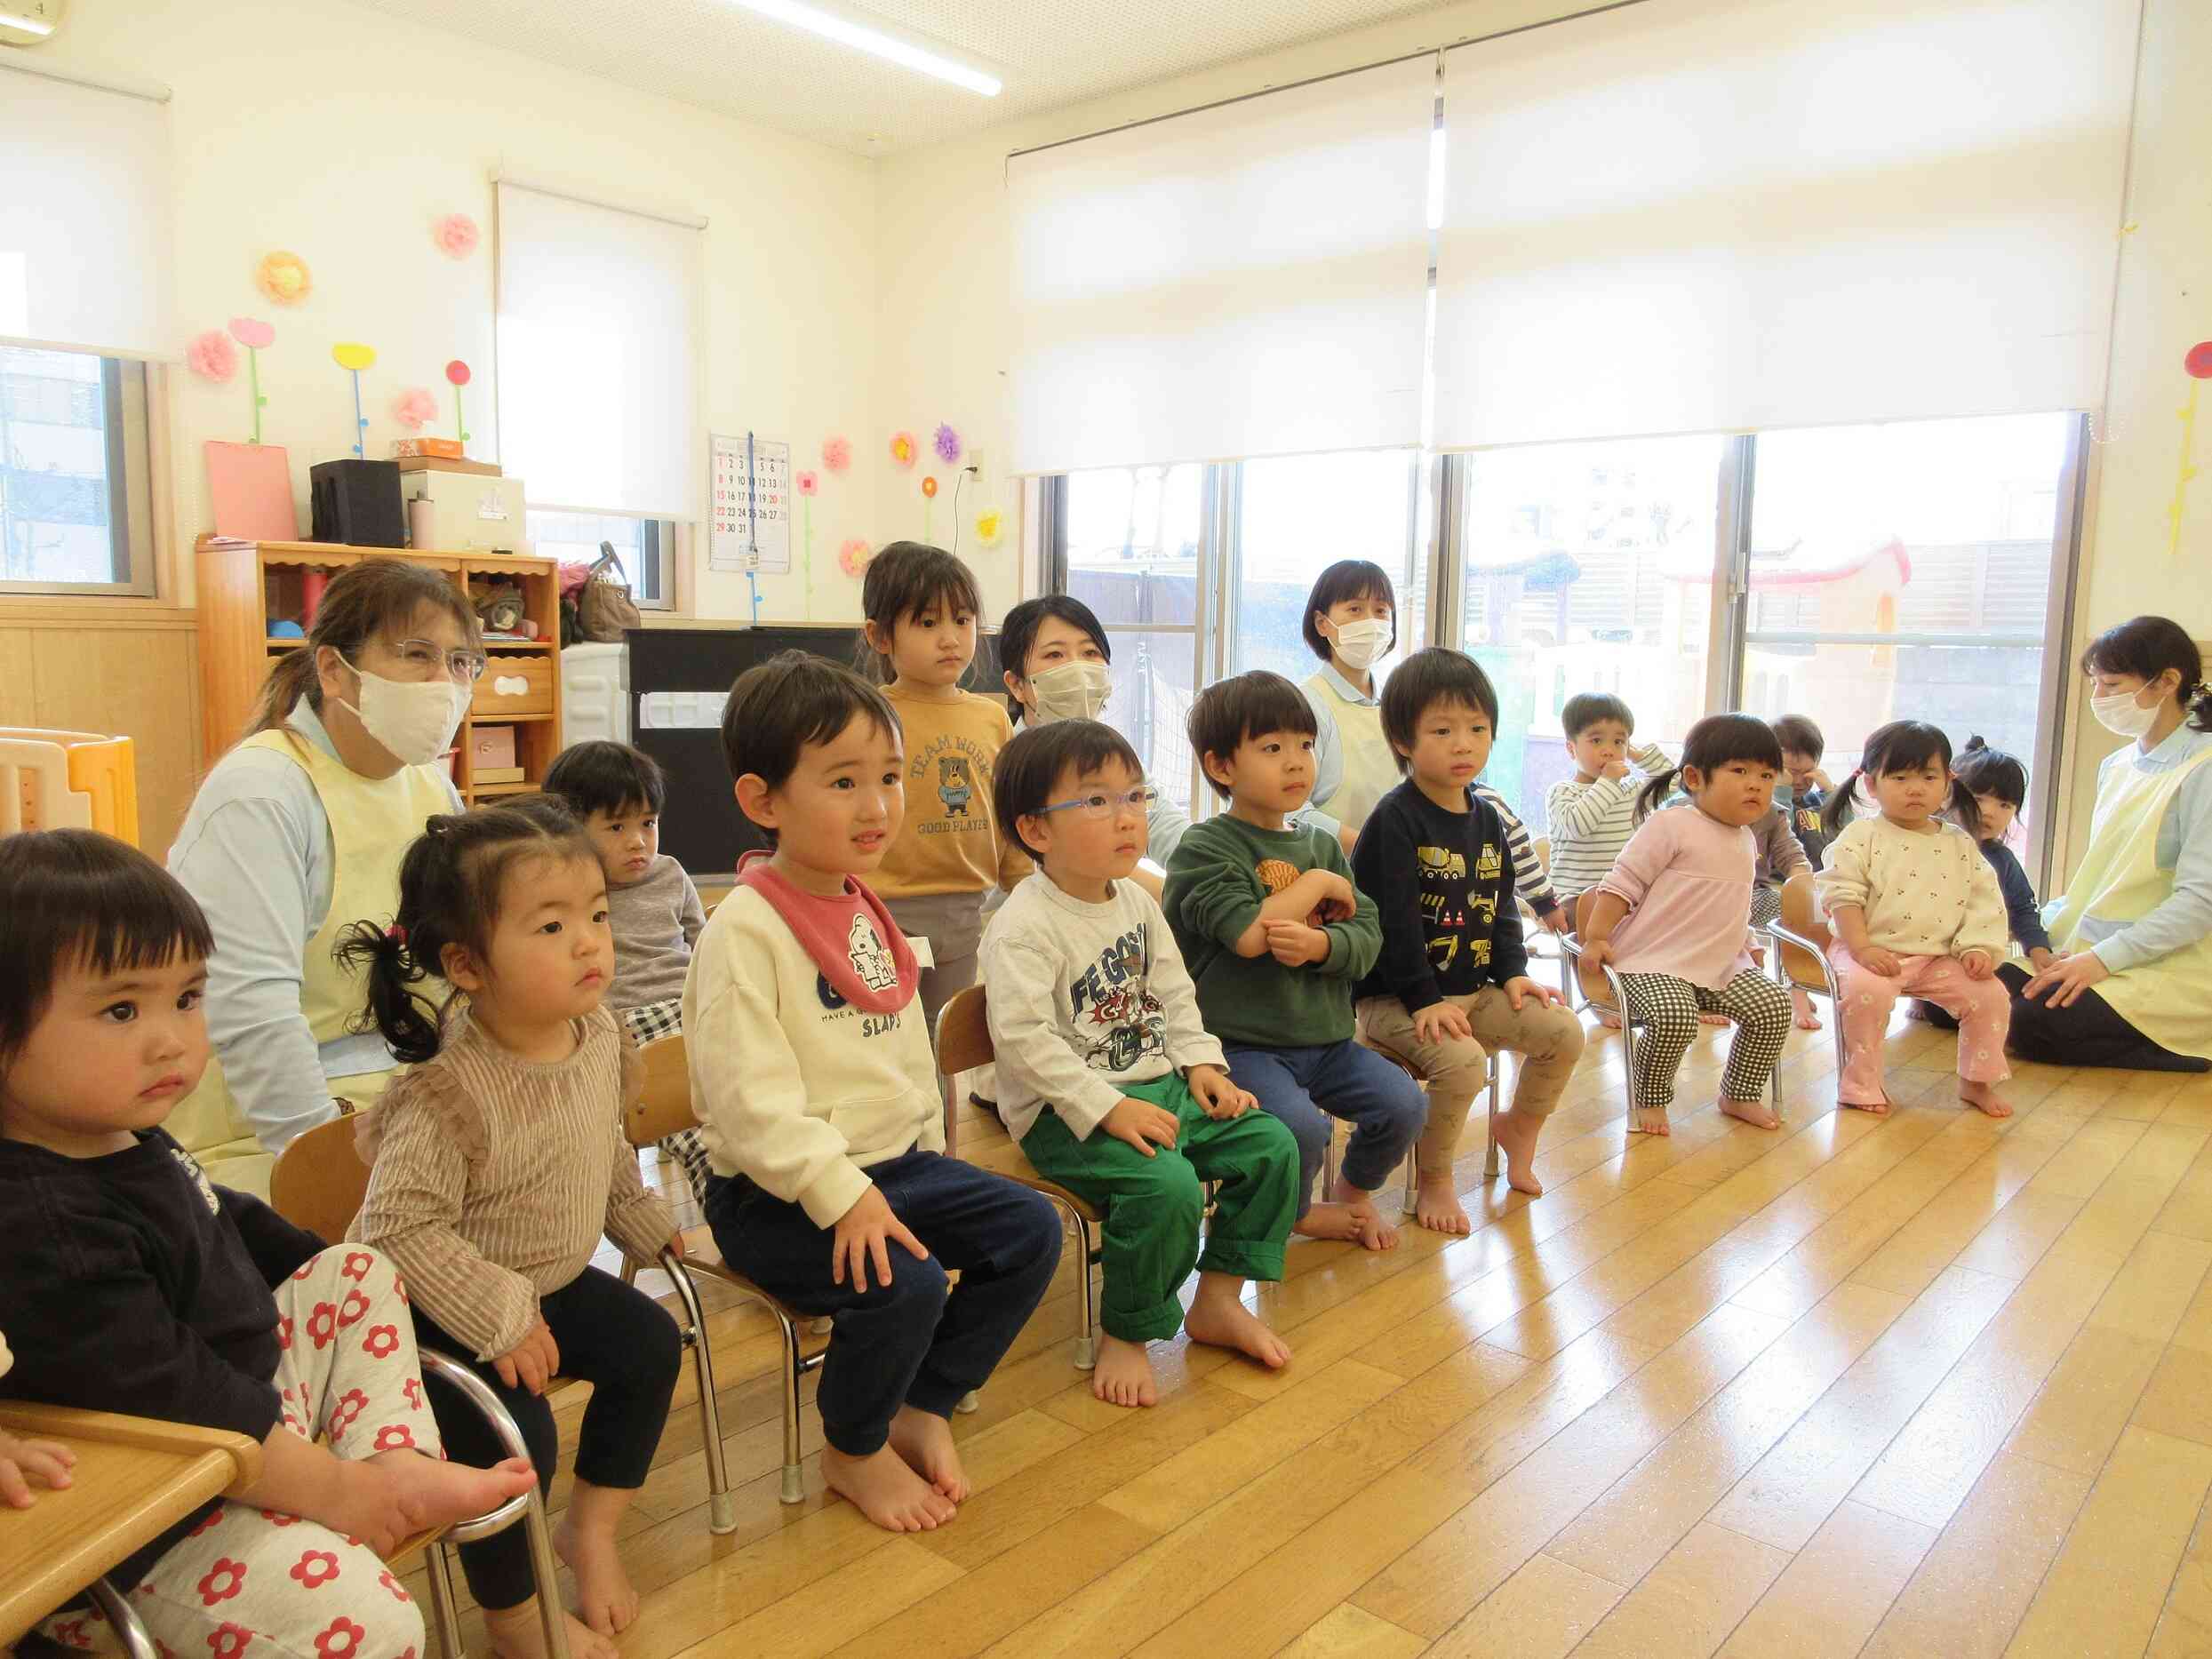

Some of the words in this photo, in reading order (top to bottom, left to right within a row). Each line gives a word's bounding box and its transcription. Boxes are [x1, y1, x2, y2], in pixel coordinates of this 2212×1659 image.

[718, 458, 723, 468] 1
[729, 459, 733, 468] 2
[739, 460, 744, 470] 3
[760, 462, 764, 472] 5
[770, 463, 775, 473] 6
[718, 474, 723, 483] 8
[729, 475, 733, 484] 9
[738, 476, 746, 485] 10
[759, 477, 766, 487] 12
[769, 478, 777, 488] 13
[717, 491, 725, 499] 15
[728, 491, 736, 500] 16
[738, 491, 746, 501] 17
[759, 493, 767, 503] 19
[768, 494, 778, 504] 20
[717, 506, 725, 516] 22
[727, 506, 736, 516] 23
[738, 507, 747, 517] 24
[759, 509, 767, 519] 26
[769, 510, 778, 519] 27
[716, 522, 725, 531] 29
[727, 522, 736, 532] 30
[739, 523, 746, 533] 31
[910, 736, 953, 778] TEAM
[917, 821, 950, 833] GOOD
[821, 1011, 845, 1022] HAVE
